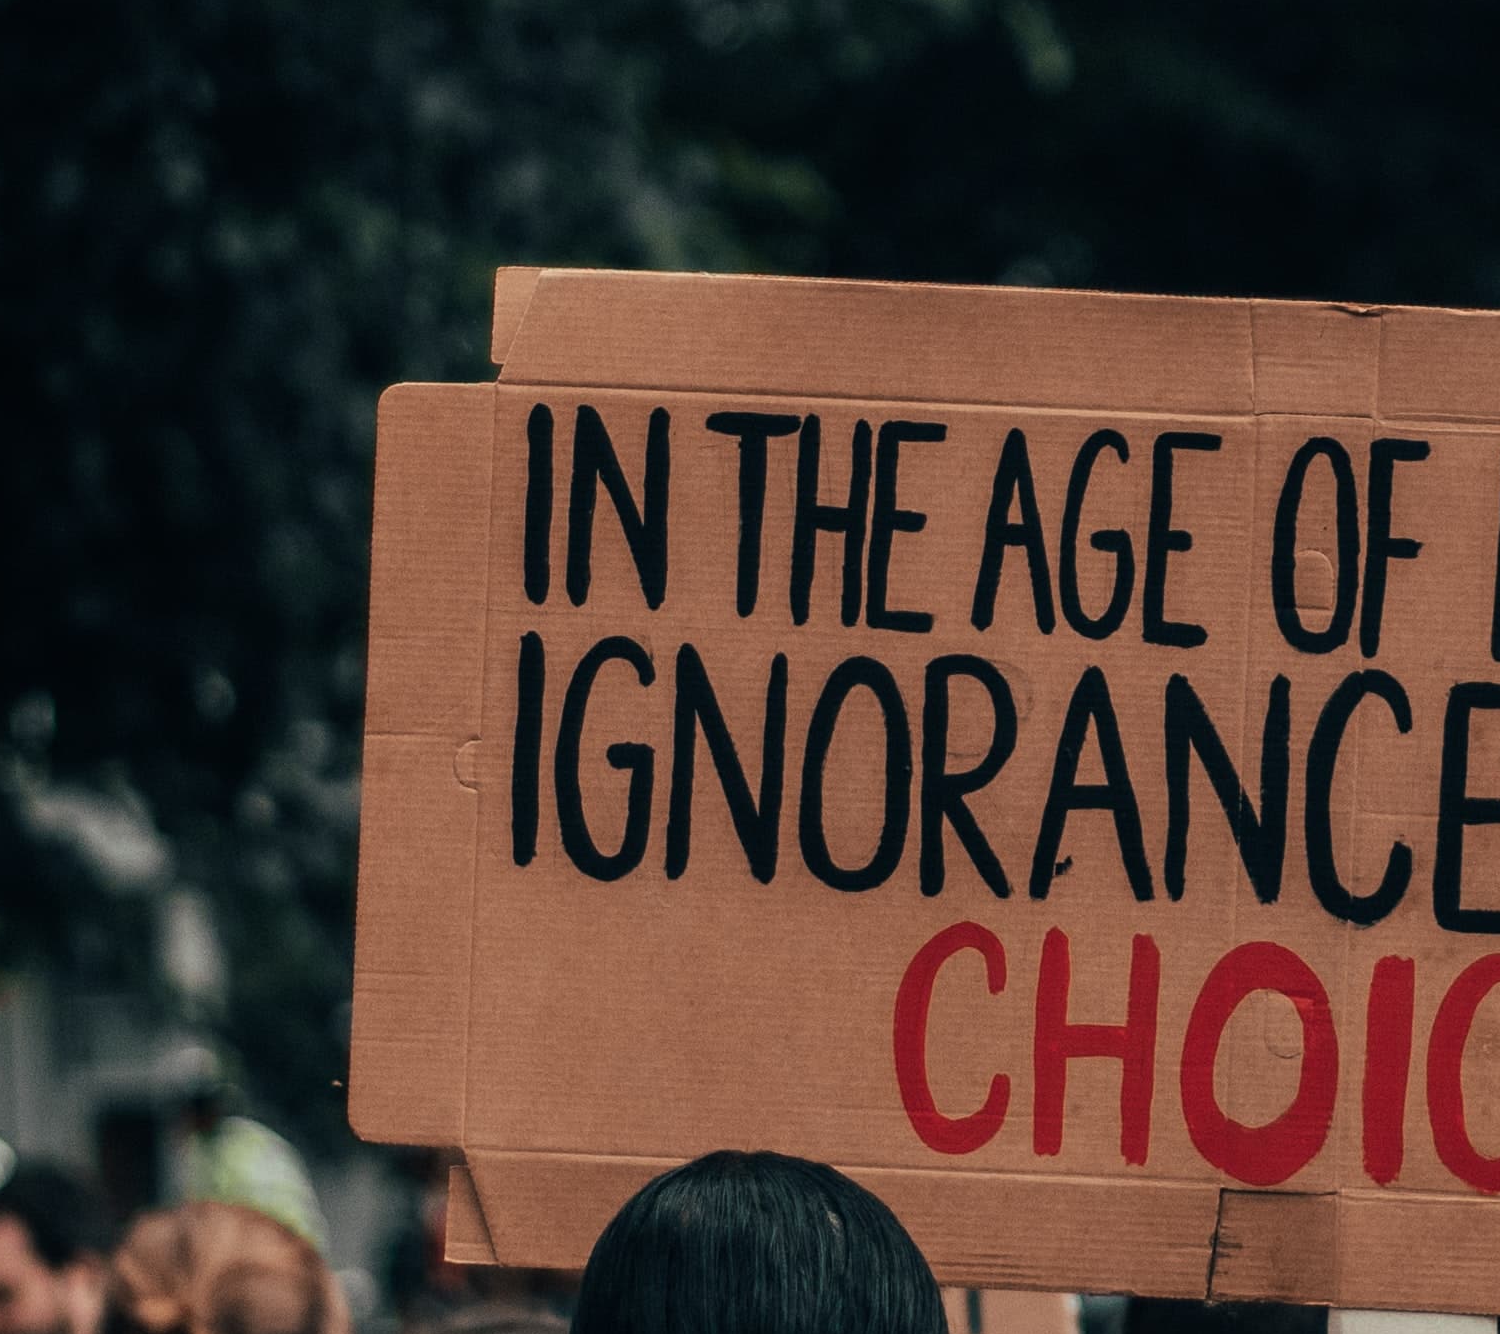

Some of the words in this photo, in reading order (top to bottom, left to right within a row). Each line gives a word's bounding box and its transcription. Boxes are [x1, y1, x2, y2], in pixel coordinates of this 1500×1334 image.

[524, 403, 670, 610] IN
[706, 412, 948, 633] THE
[970, 428, 1223, 647] AGE
[1272, 435, 1431, 657] OF
